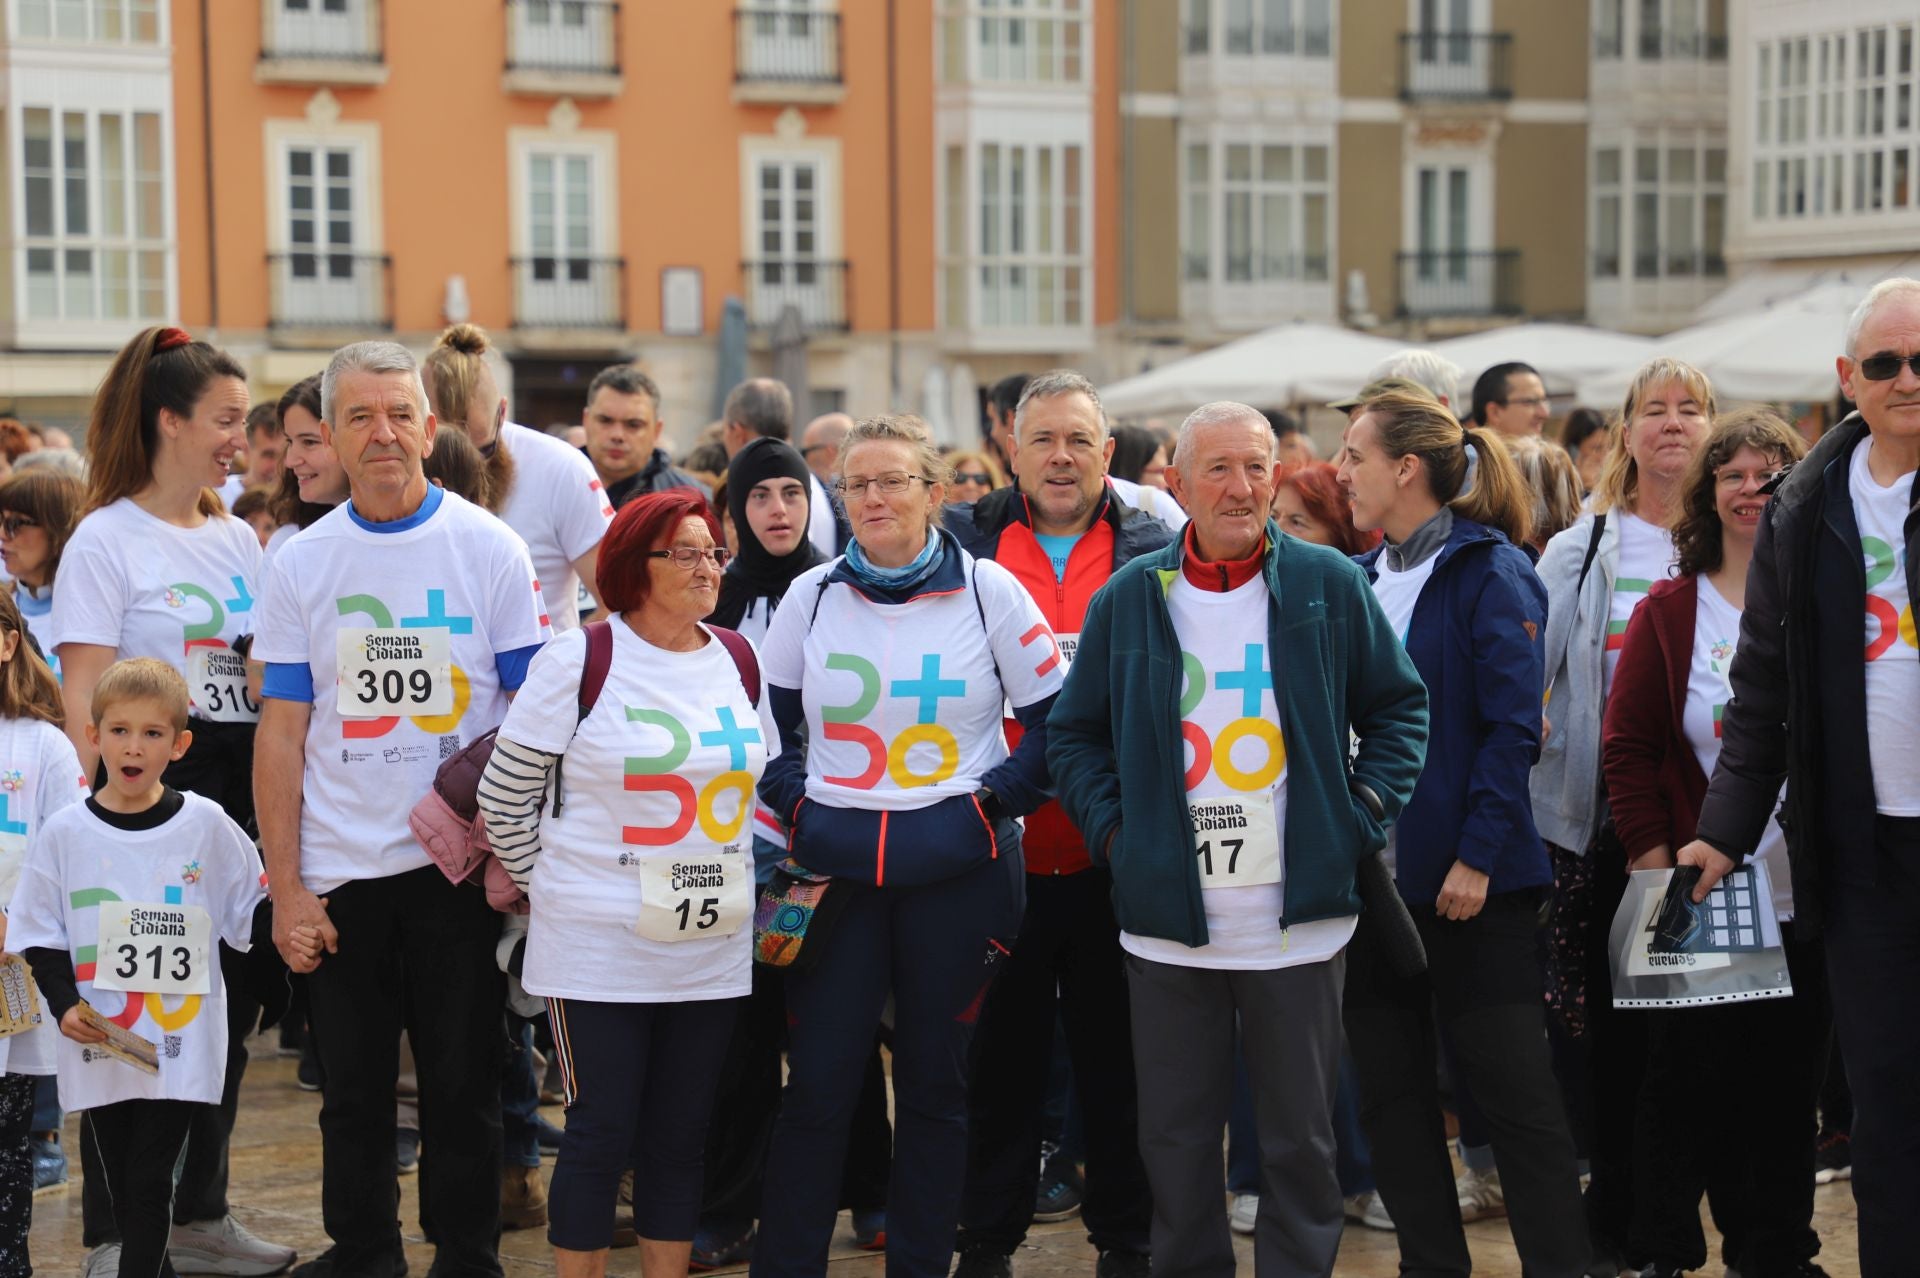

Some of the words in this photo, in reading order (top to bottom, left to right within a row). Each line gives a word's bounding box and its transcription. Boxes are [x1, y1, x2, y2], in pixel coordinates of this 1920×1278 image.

[366, 634, 420, 648] Semana
[208, 652, 244, 666] Semana
[366, 647, 423, 662] Cidiana
[208, 664, 247, 677] Cidiana
[357, 669, 432, 704] 309
[1190, 804, 1243, 818] Semana
[1197, 839, 1244, 875] 17
[672, 863, 722, 876] Semana
[672, 875, 724, 891] Cidiana
[131, 908, 184, 923] Semana
[675, 898, 719, 931] 15
[130, 921, 186, 936] Cidiana
[116, 944, 191, 981] 313
